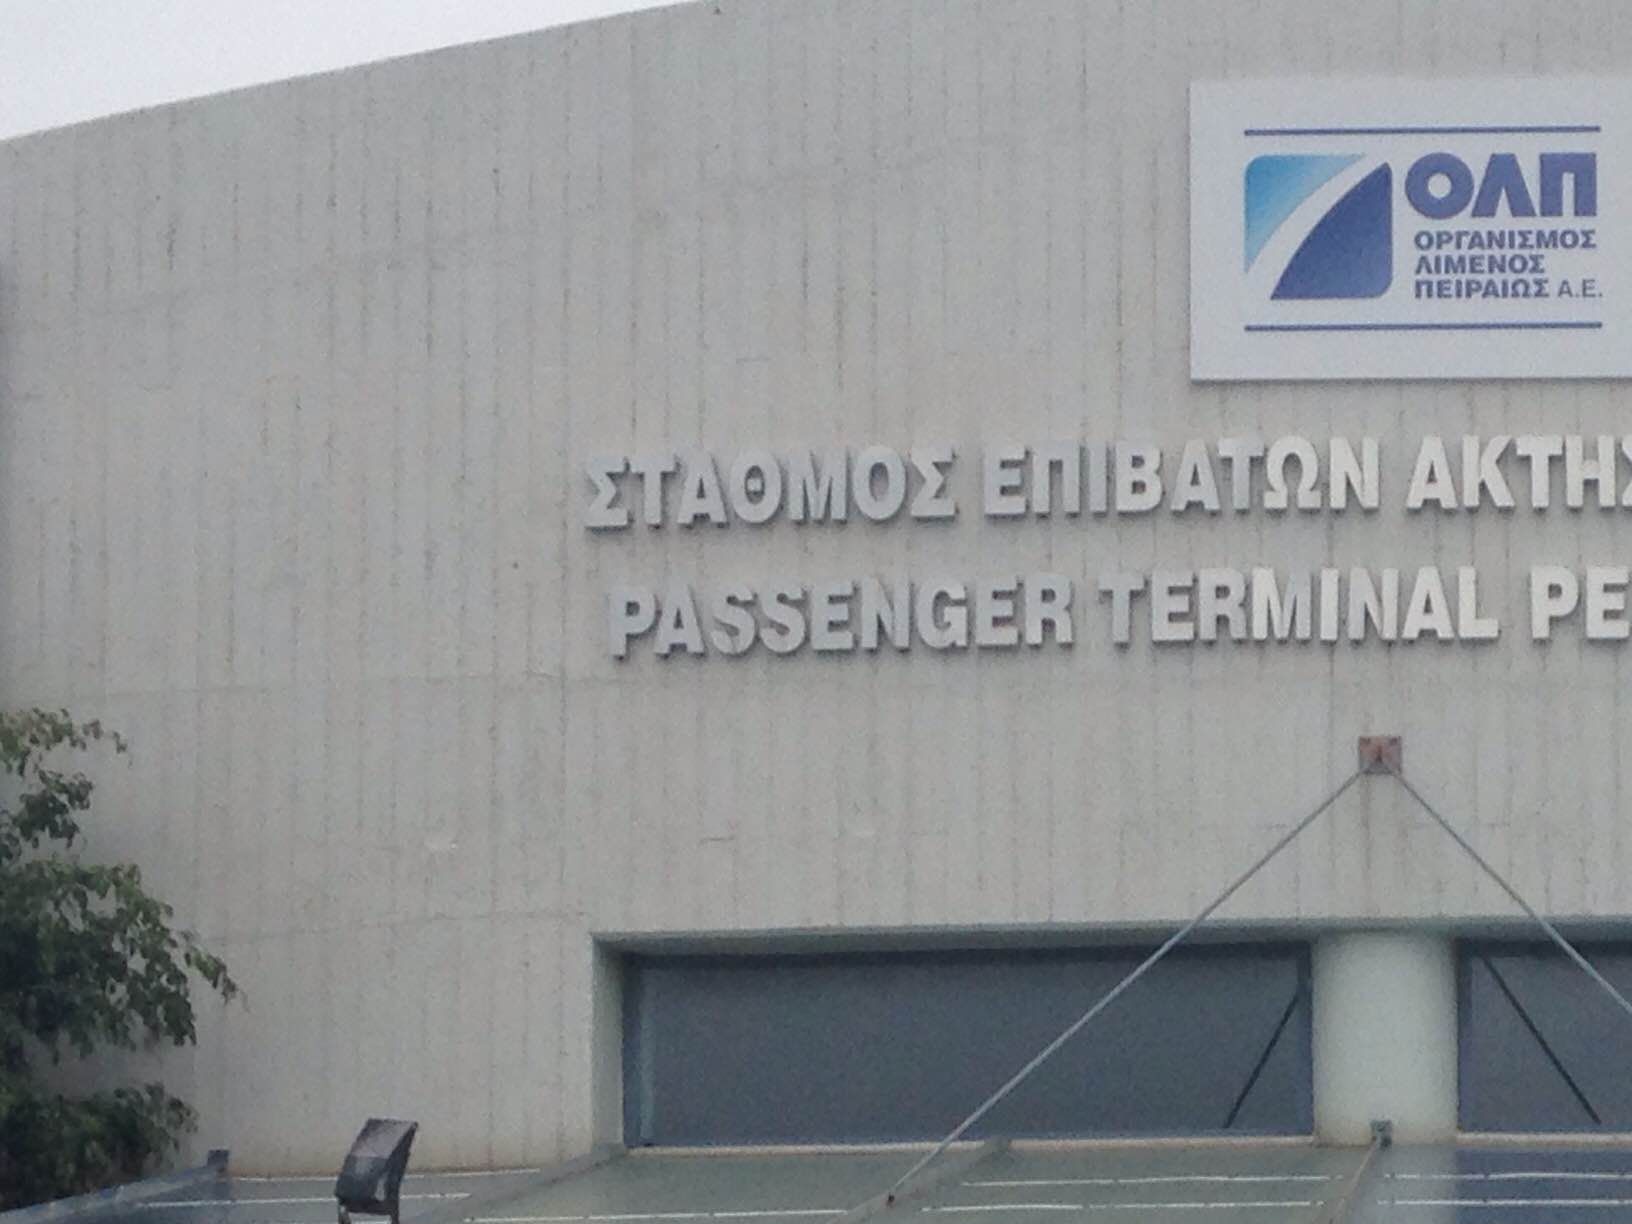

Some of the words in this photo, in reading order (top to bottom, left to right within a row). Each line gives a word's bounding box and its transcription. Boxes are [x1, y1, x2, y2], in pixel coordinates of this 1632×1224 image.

[1405, 152, 1597, 219] ΟΛΠ
[1413, 229, 1597, 251] ΟΡΓΑΝΙΣΜΟΣ
[1414, 254, 1545, 275] ΛΙΜΕΝΟΣ
[1414, 278, 1550, 299] ΠΕΙΡΑΙΩΣ
[584, 445, 960, 530] ΣΤΑΘΜΟΣ
[984, 436, 1381, 519] ΕΠΙΒΑΤΩΝ
[608, 571, 1076, 660] PASSENGER
[1097, 564, 1499, 648] TERMINAL
